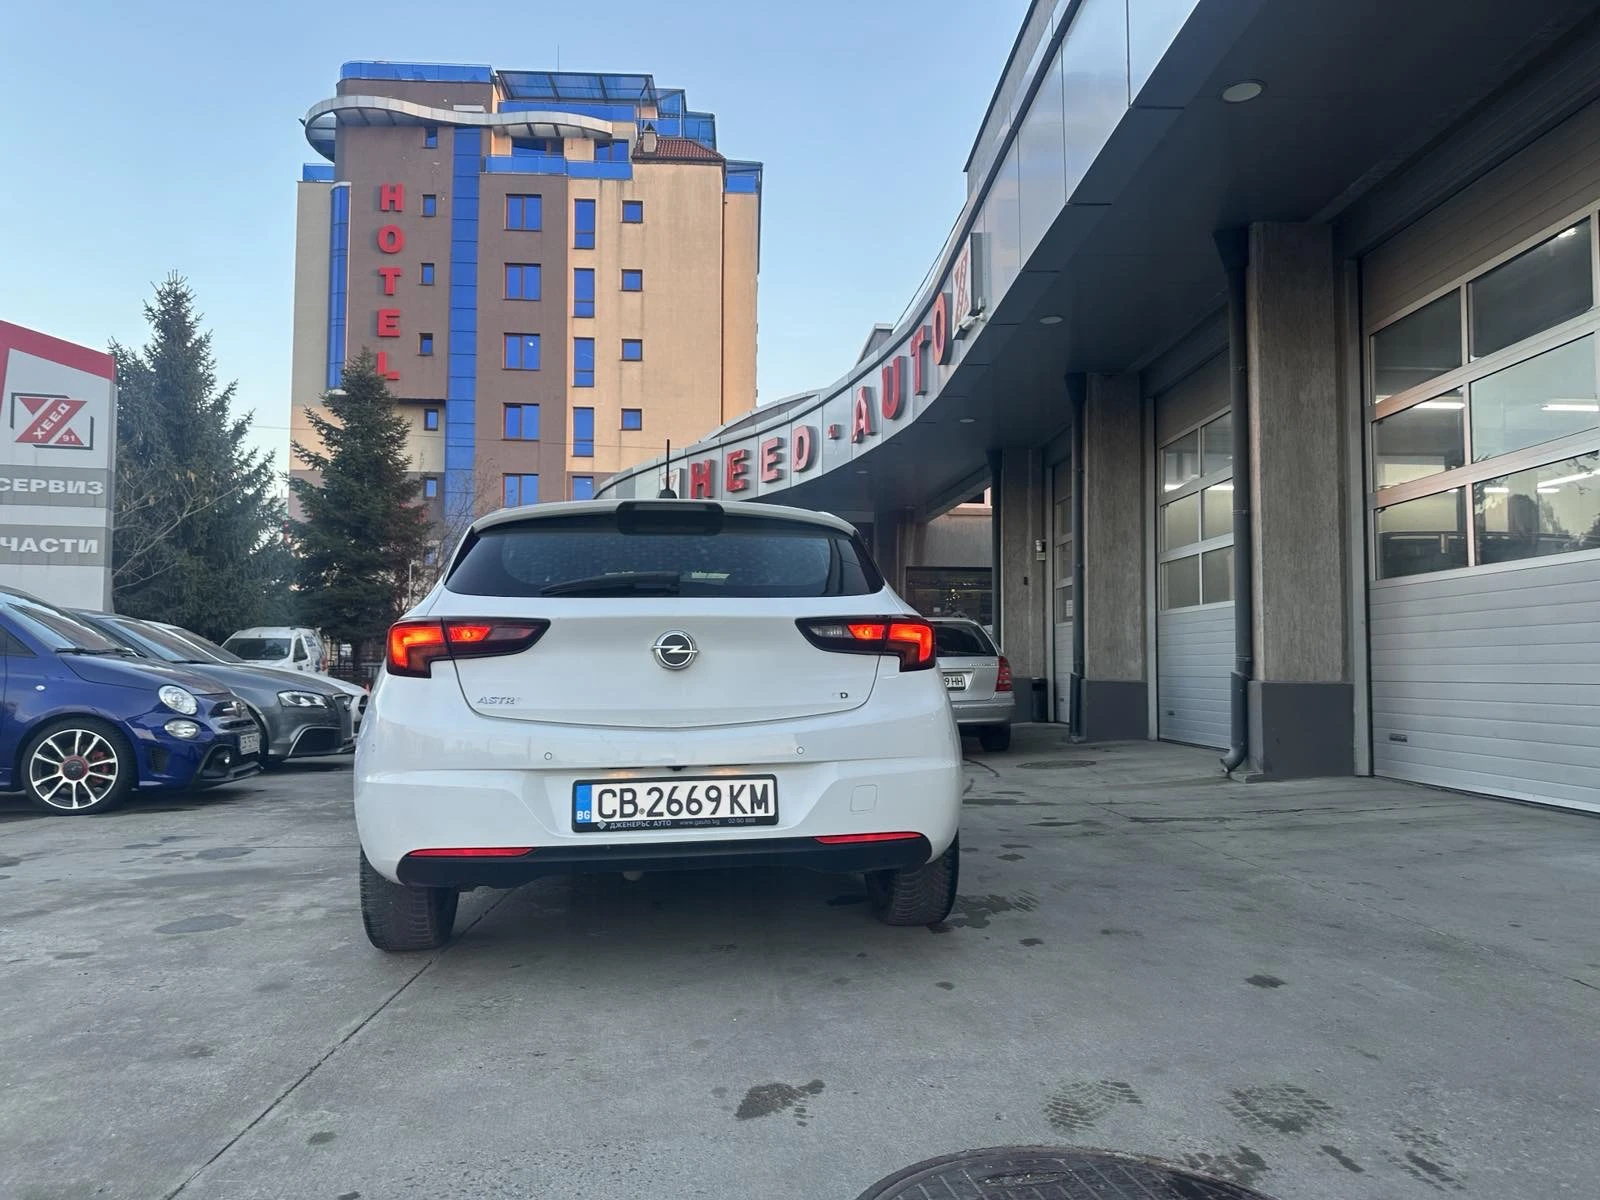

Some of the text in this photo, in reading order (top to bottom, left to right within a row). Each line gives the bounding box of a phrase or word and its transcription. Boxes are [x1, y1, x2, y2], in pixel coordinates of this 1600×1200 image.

[376, 183, 406, 380] HOTEL
[62, 434, 76, 442] 91
[0, 477, 104, 495] СЕРВИЗ
[0, 536, 99, 554] ЧАСТИ
[576, 810, 591, 820] BG
